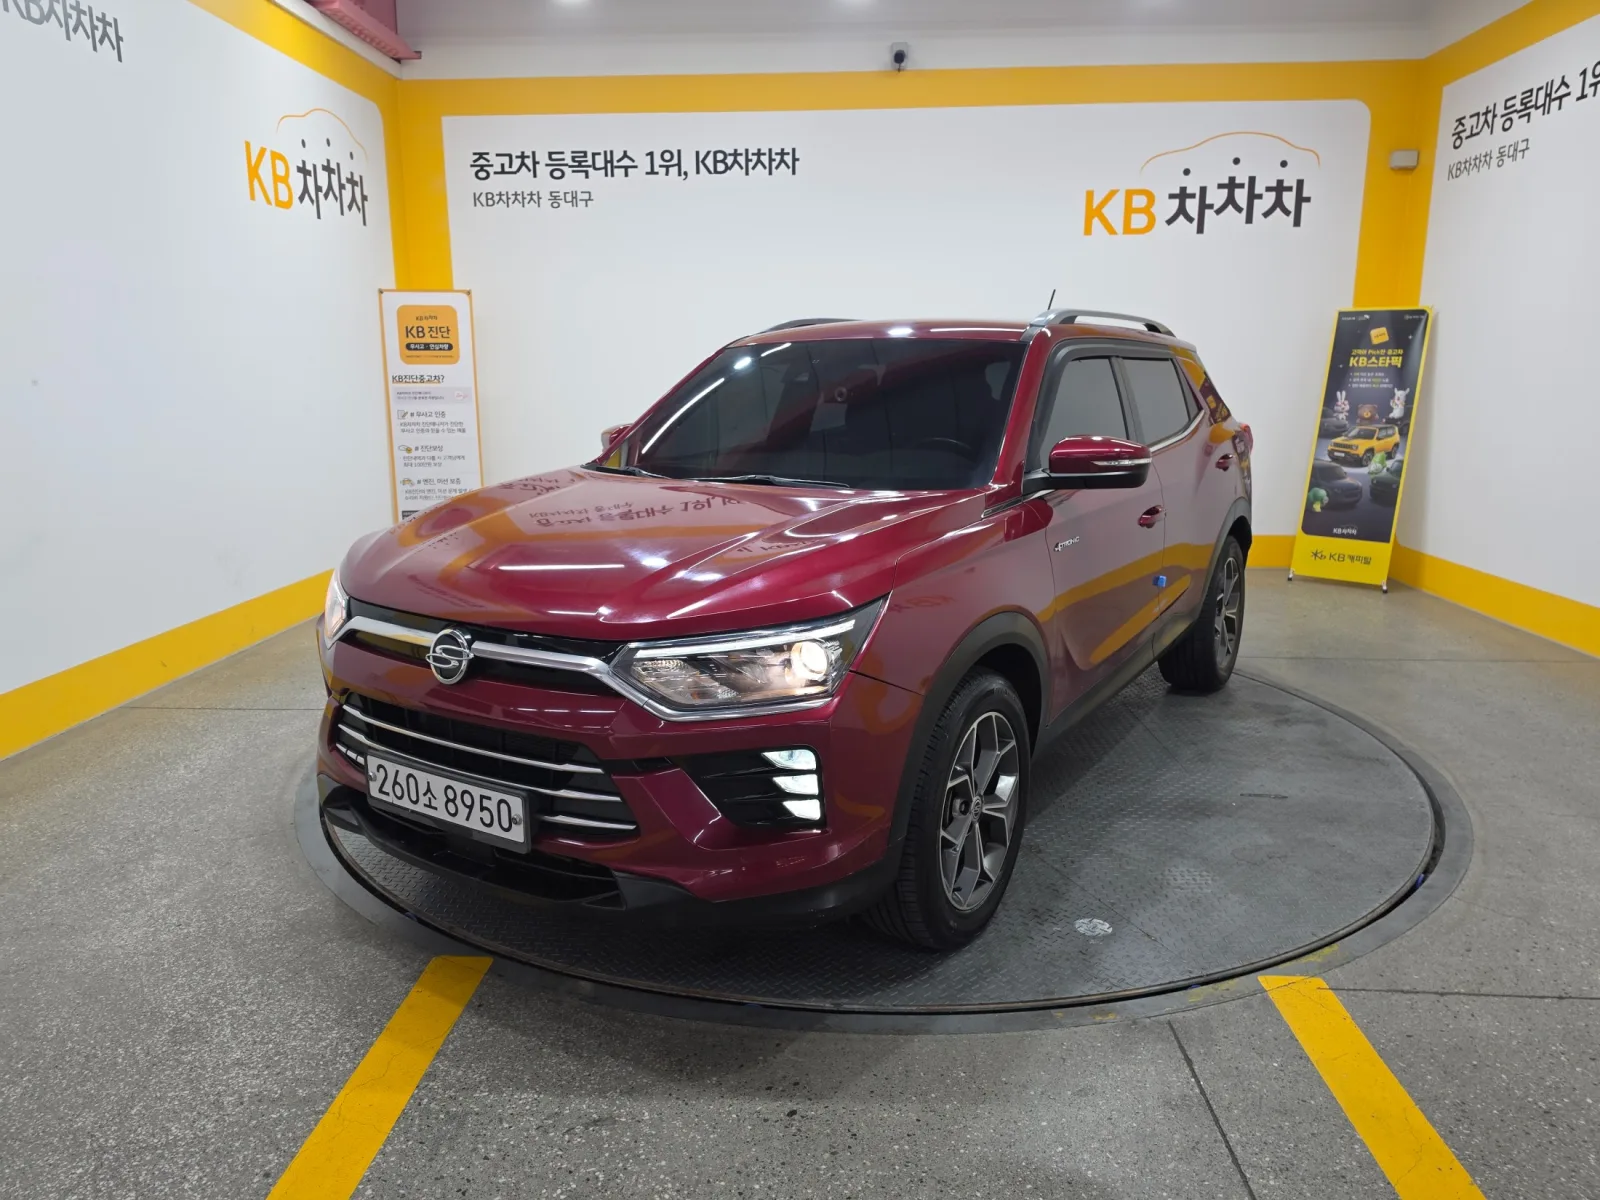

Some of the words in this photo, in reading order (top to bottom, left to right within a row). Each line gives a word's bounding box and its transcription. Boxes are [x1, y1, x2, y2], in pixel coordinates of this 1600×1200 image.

[1452, 103, 1497, 150] 중고차
[1500, 75, 1572, 132] 등록대수
[469, 150, 540, 181] 중고차
[544, 148, 638, 180] 등록대수
[644, 148, 689, 180] 1위,
[695, 147, 800, 177] KB차차차
[1447, 149, 1493, 181] KB차차차
[1496, 138, 1530, 168] 동대구
[473, 191, 542, 208] KB차차차
[547, 190, 595, 209] 동대구
[405, 325, 426, 339] KB
[427, 325, 451, 339] 진단
[1349, 356, 1403, 369] KB스타픽
[392, 374, 445, 384] KB진단중고차?
[1328, 552, 1346, 562] KB
[1347, 554, 1372, 565] 캐피탈
